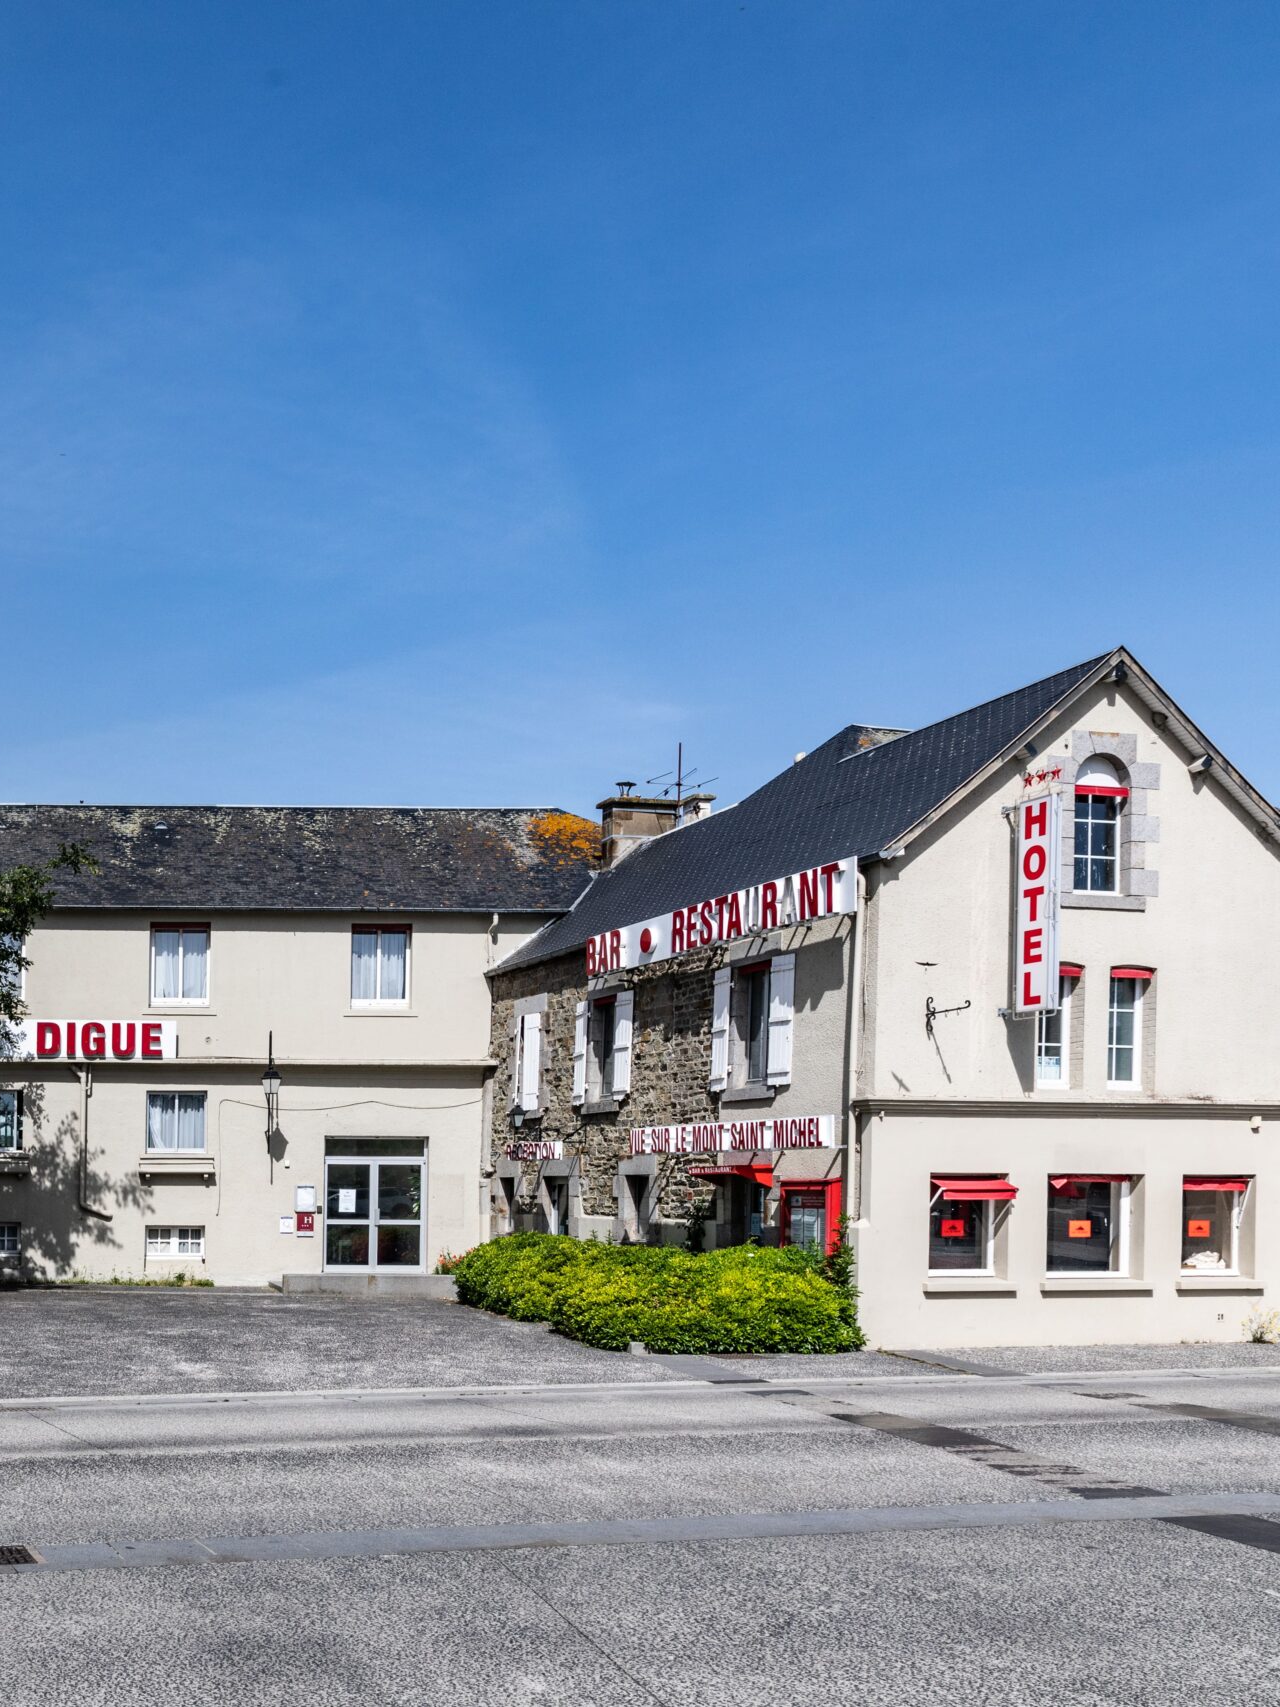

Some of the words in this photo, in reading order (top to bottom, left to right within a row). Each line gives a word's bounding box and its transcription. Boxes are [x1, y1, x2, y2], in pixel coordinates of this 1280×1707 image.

[586, 930, 621, 976] BAR
[672, 862, 841, 953] RESTAURANT
[1023, 801, 1047, 1006] HOTEL
[36, 1021, 163, 1058] DIGUE
[629, 1129, 645, 1154] VUE
[651, 1128, 669, 1153] SUR
[676, 1126, 687, 1151] LE
[692, 1124, 724, 1151] MONT
[730, 1121, 766, 1150] SAINT
[773, 1117, 823, 1148] MICHEL
[304, 1216, 312, 1224] H
